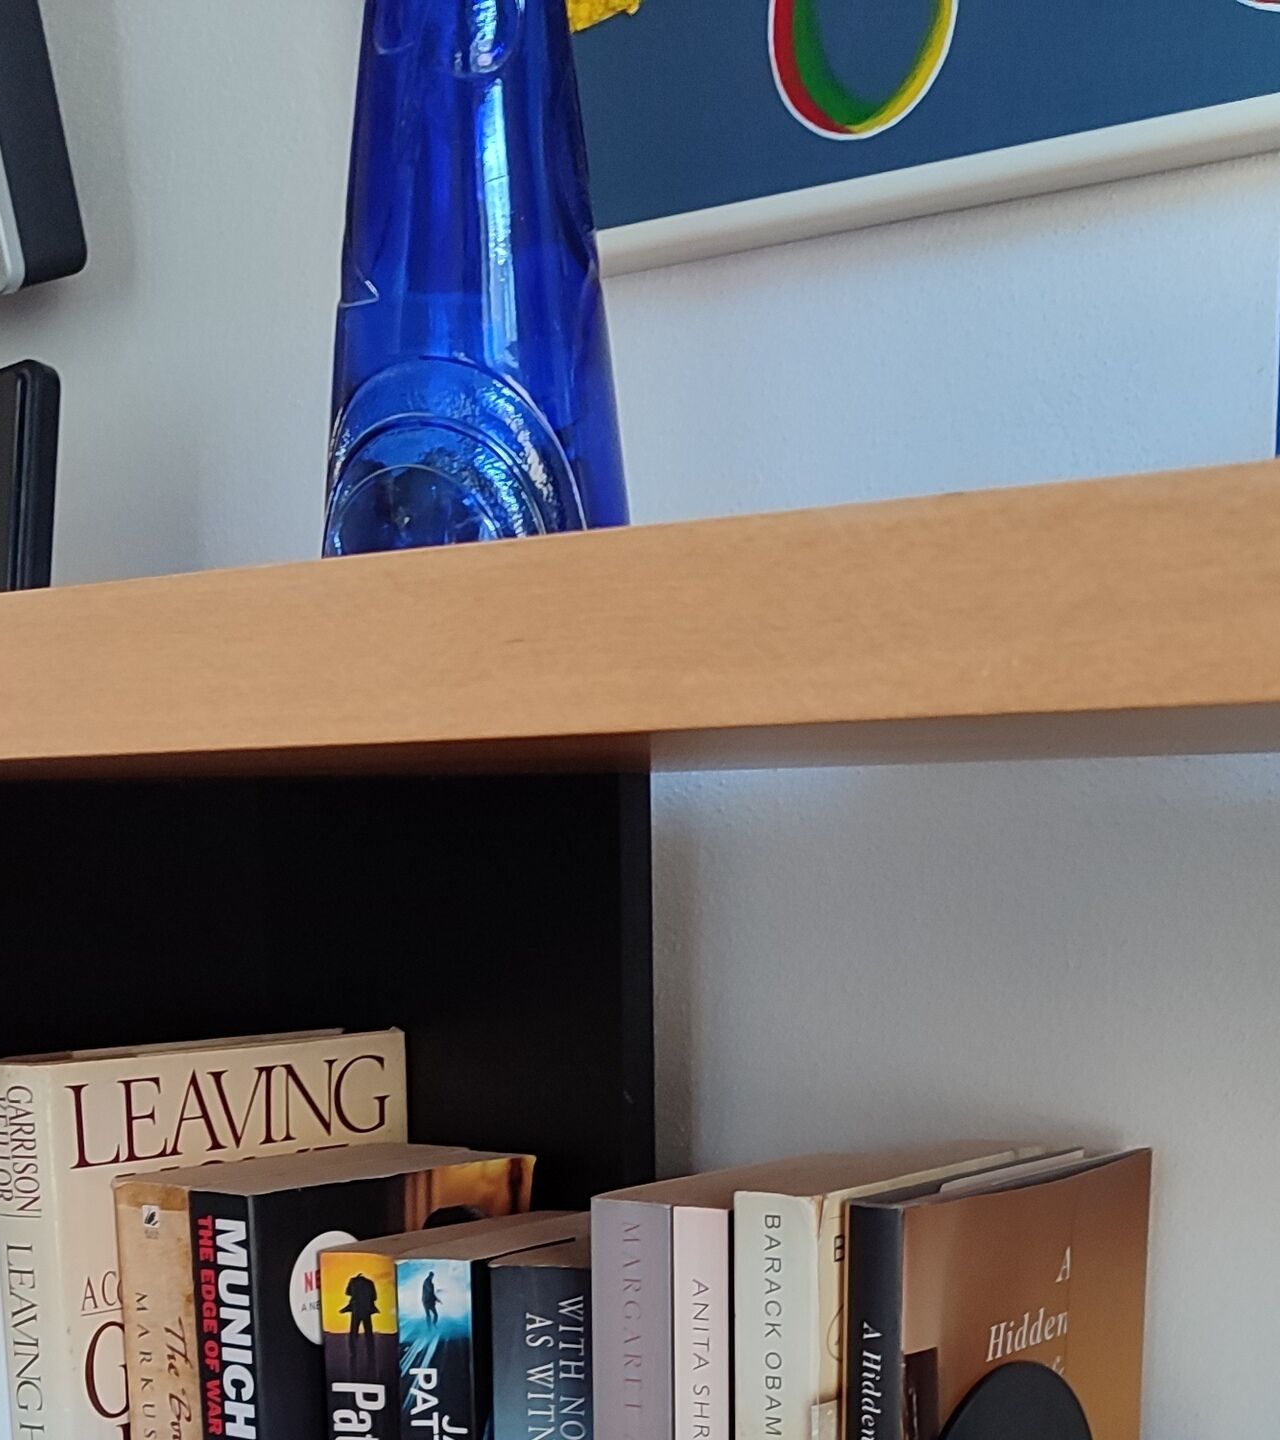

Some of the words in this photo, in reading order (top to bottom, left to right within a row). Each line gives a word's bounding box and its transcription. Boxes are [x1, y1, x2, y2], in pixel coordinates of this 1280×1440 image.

[6, 1085, 42, 1213] GARRISON
[64, 1055, 391, 1169] LEAVING
[197, 1215, 215, 1262] THE
[1055, 1246, 1071, 1284] A
[200, 1268, 218, 1335] EDGE
[621, 1220, 643, 1409] MARGARET
[763, 1214, 782, 1340] BARACK
[6, 1244, 45, 1411] LEAVING
[164, 1316, 194, 1378] The
[203, 1340, 220, 1373] OF
[215, 1217, 257, 1440] MUNICH
[524, 1311, 554, 1348] AS
[557, 1295, 586, 1380] WITH
[691, 1278, 710, 1372] ANITA
[861, 1321, 882, 1341] A
[985, 1306, 1069, 1363] Hidden
[136, 1292, 158, 1440] MARKUS
[205, 1378, 224, 1437] WAR
